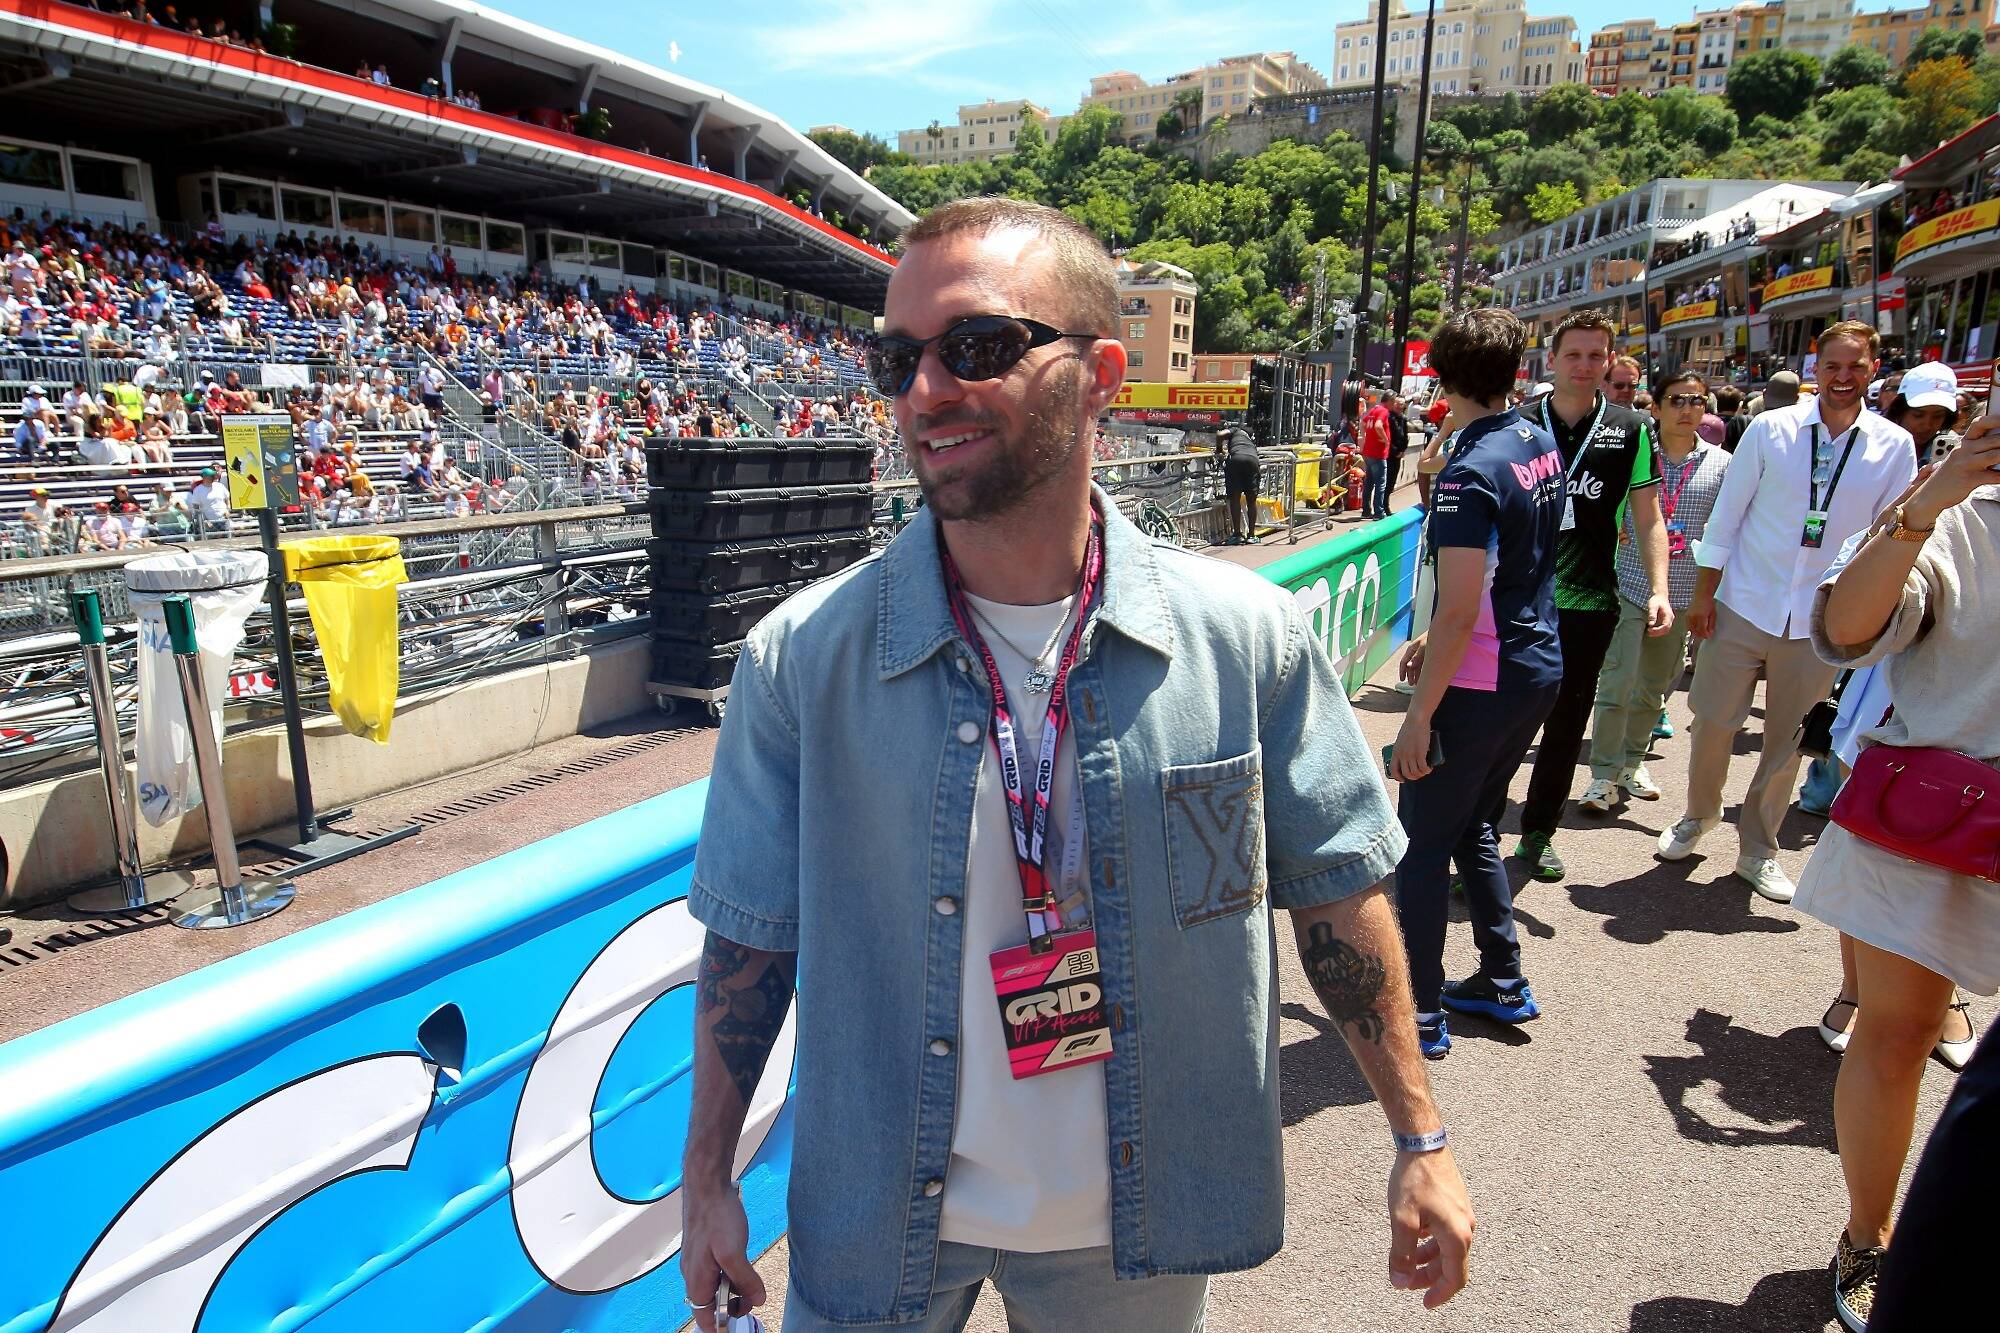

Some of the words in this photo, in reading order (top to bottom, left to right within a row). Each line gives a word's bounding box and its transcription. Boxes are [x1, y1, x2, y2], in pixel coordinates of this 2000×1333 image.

[1931, 209, 1983, 240] DHL
[1788, 271, 1823, 290] DHL
[1168, 387, 1247, 405] PIRELLI
[1147, 412, 1171, 420] CASINO
[1187, 413, 1212, 421] CASINO
[1594, 423, 1626, 439] Stake
[1566, 470, 1604, 499] ake
[985, 655, 1005, 704] MONACO
[1051, 656, 1071, 706] MONACO
[1004, 757, 1018, 790] GRID
[1038, 759, 1051, 792] GRID
[1006, 982, 1102, 1026] GRID
[1052, 1008, 1101, 1035] Access
[1064, 1033, 1102, 1053] F1
